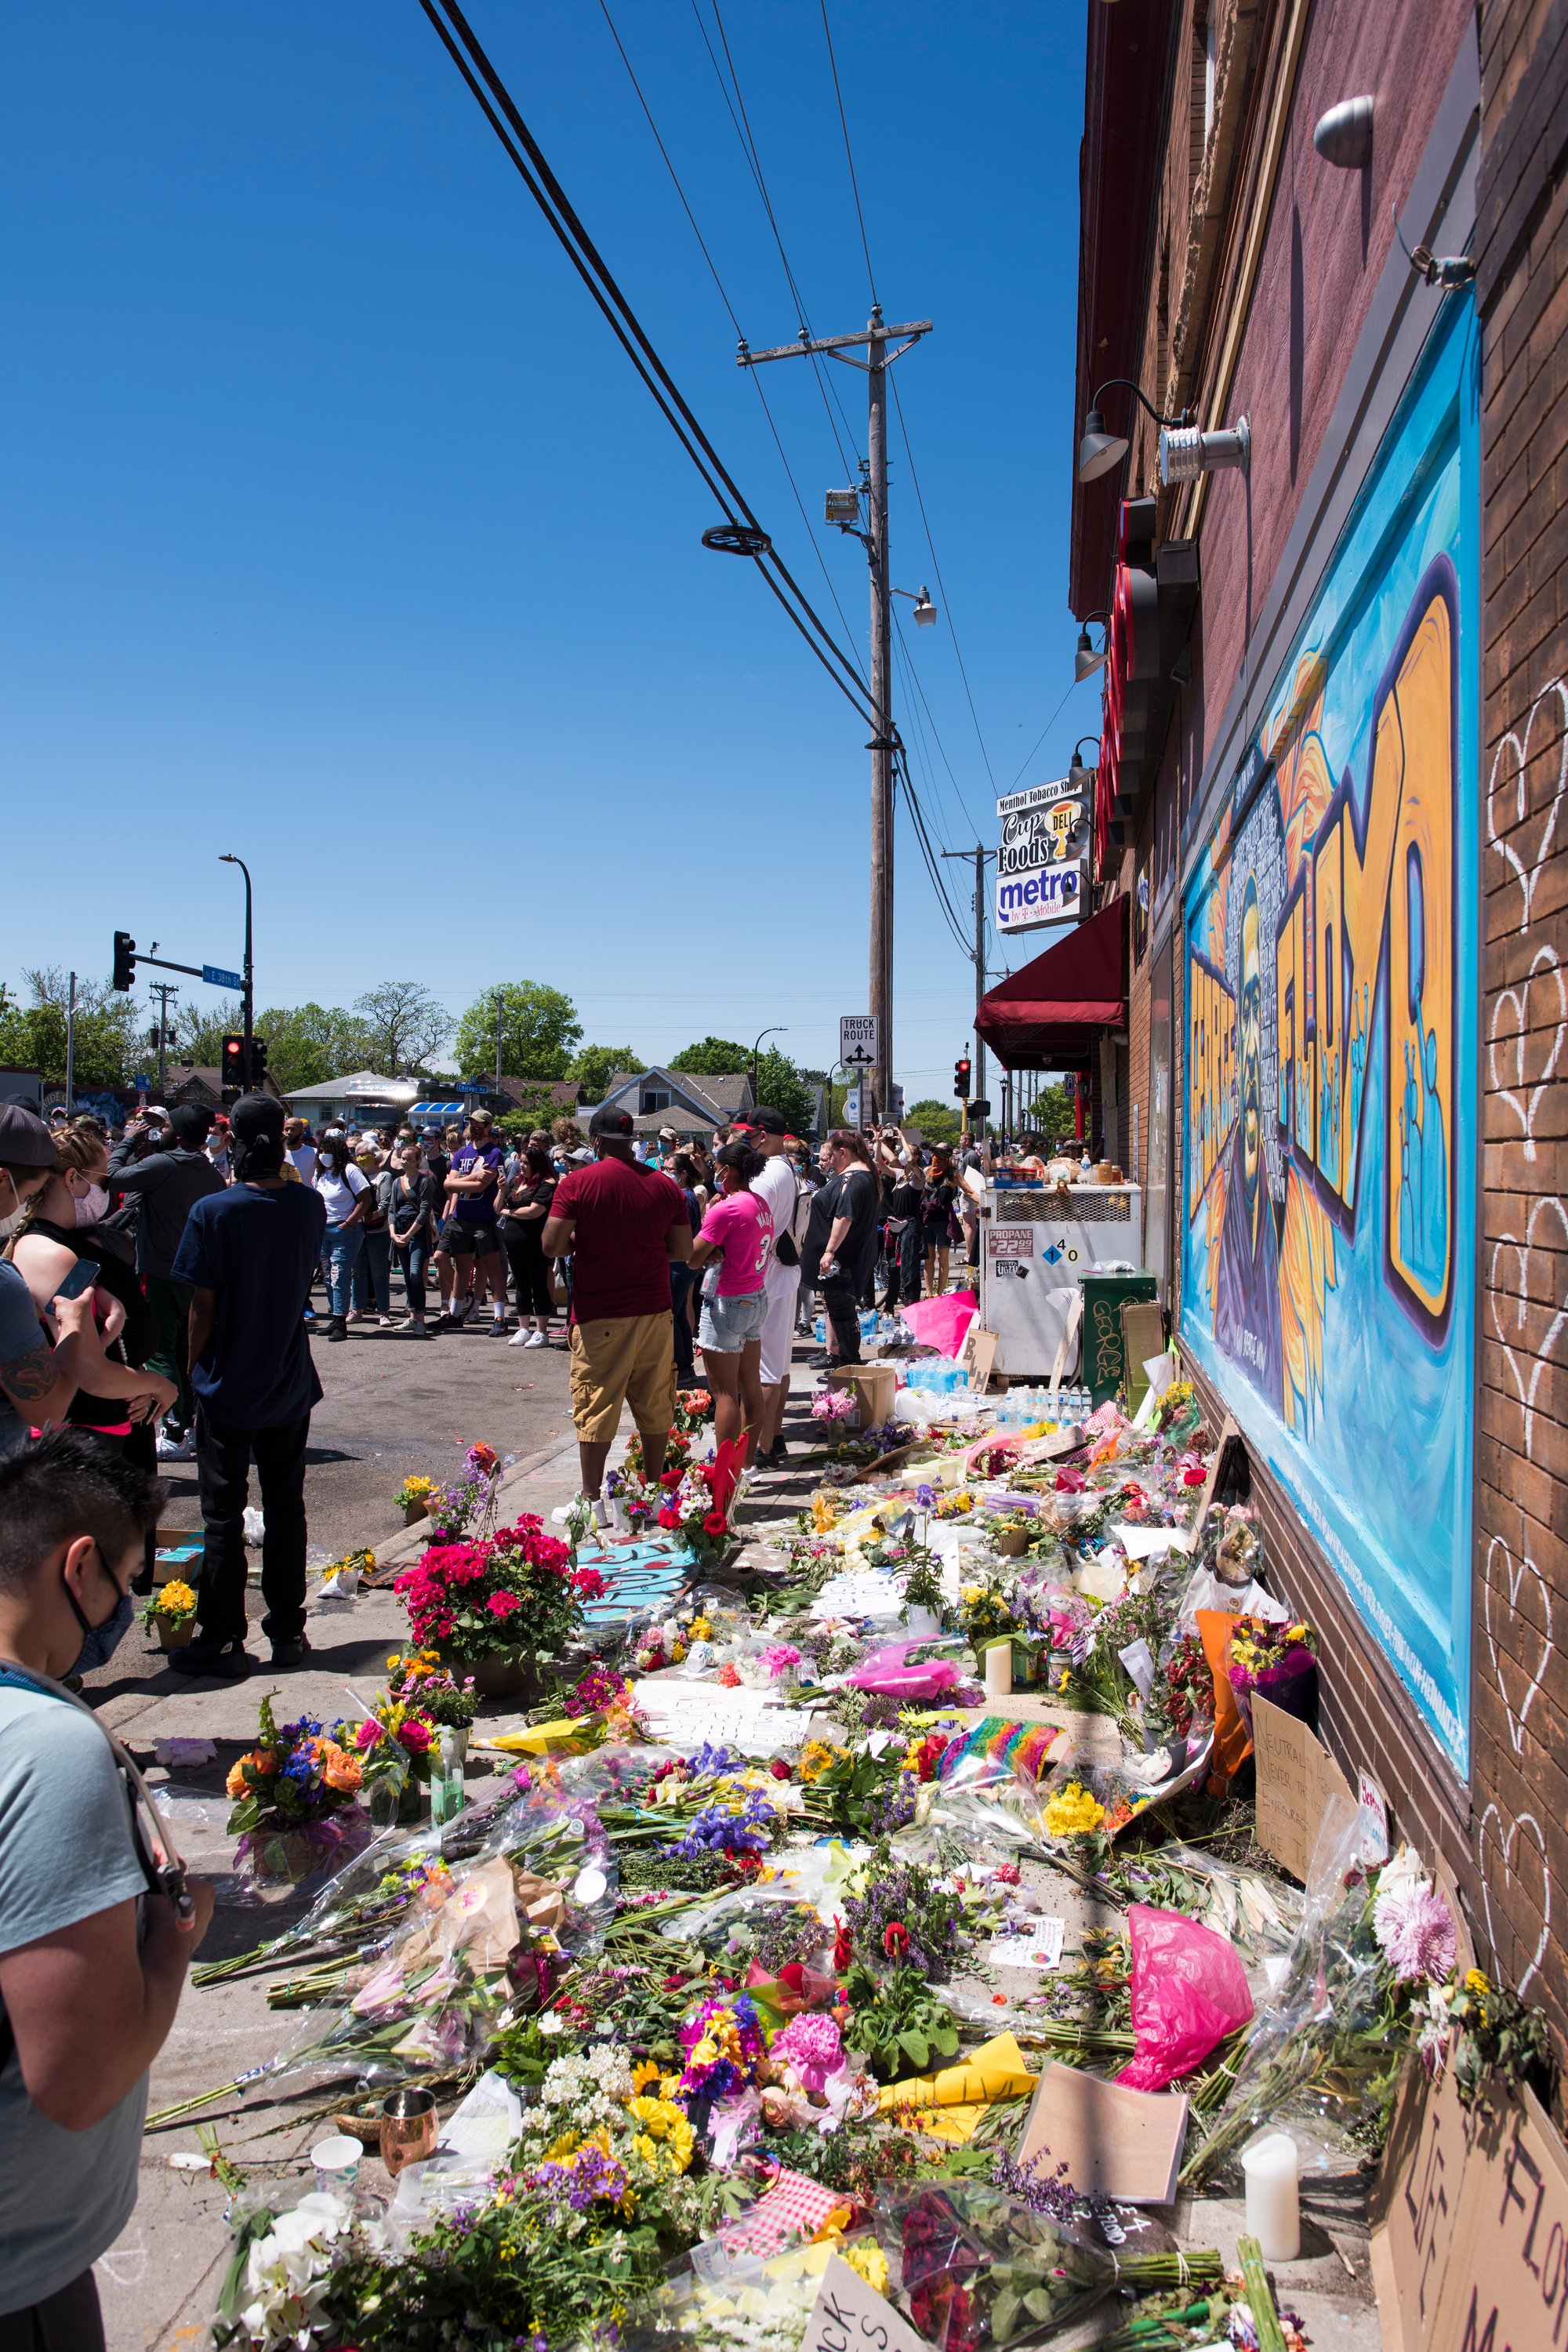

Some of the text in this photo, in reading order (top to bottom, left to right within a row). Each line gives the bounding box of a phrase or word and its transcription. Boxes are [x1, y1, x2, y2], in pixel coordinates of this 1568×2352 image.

[1000, 793, 1027, 812] Menthol
[1029, 784, 1058, 804] Tobacco
[1003, 813, 1045, 845] Cup
[1053, 811, 1072, 831] DELI
[998, 837, 1048, 873] Foods
[999, 869, 1077, 912] metro
[1011, 911, 1021, 923] by
[1035, 902, 1062, 917] Mobile
[212, 971, 240, 987] E 38th St
[844, 1018, 874, 1029] TRUCK
[844, 1030, 875, 1040] ROUTE
[755, 1212, 773, 1229] WADE
[989, 1230, 1033, 1239] PROPANE
[1057, 1239, 1066, 1250] 4
[754, 1234, 771, 1274] 3
[1048, 1250, 1054, 1261] 1
[1069, 1250, 1078, 1261] 0
[1093, 1301, 1122, 1387] GEORGE
[1259, 1751, 1292, 1792] NEVER
[1262, 1821, 1283, 1851] THE
